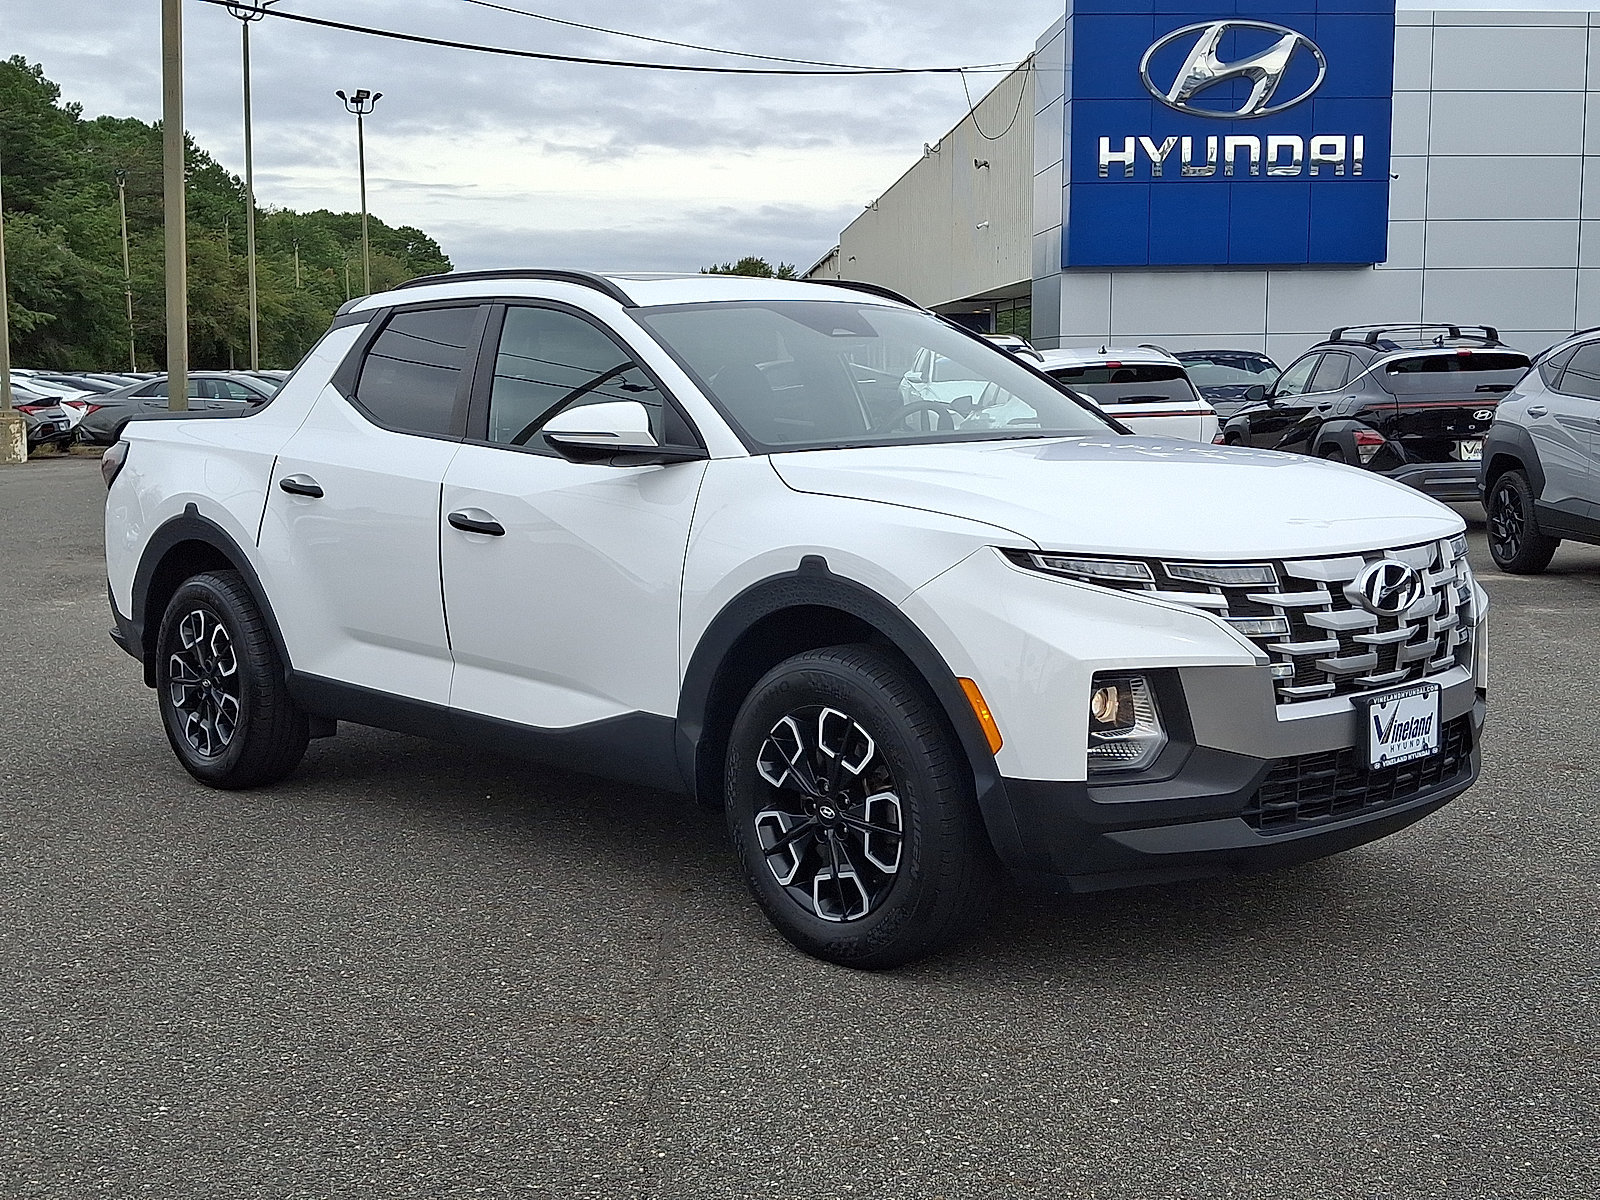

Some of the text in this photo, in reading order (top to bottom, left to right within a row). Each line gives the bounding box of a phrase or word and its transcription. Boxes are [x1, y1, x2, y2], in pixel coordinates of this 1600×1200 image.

[1098, 135, 1364, 178] HYUNDAI
[1373, 699, 1434, 745] Vineland
[1390, 735, 1431, 753] HYUNDAI
